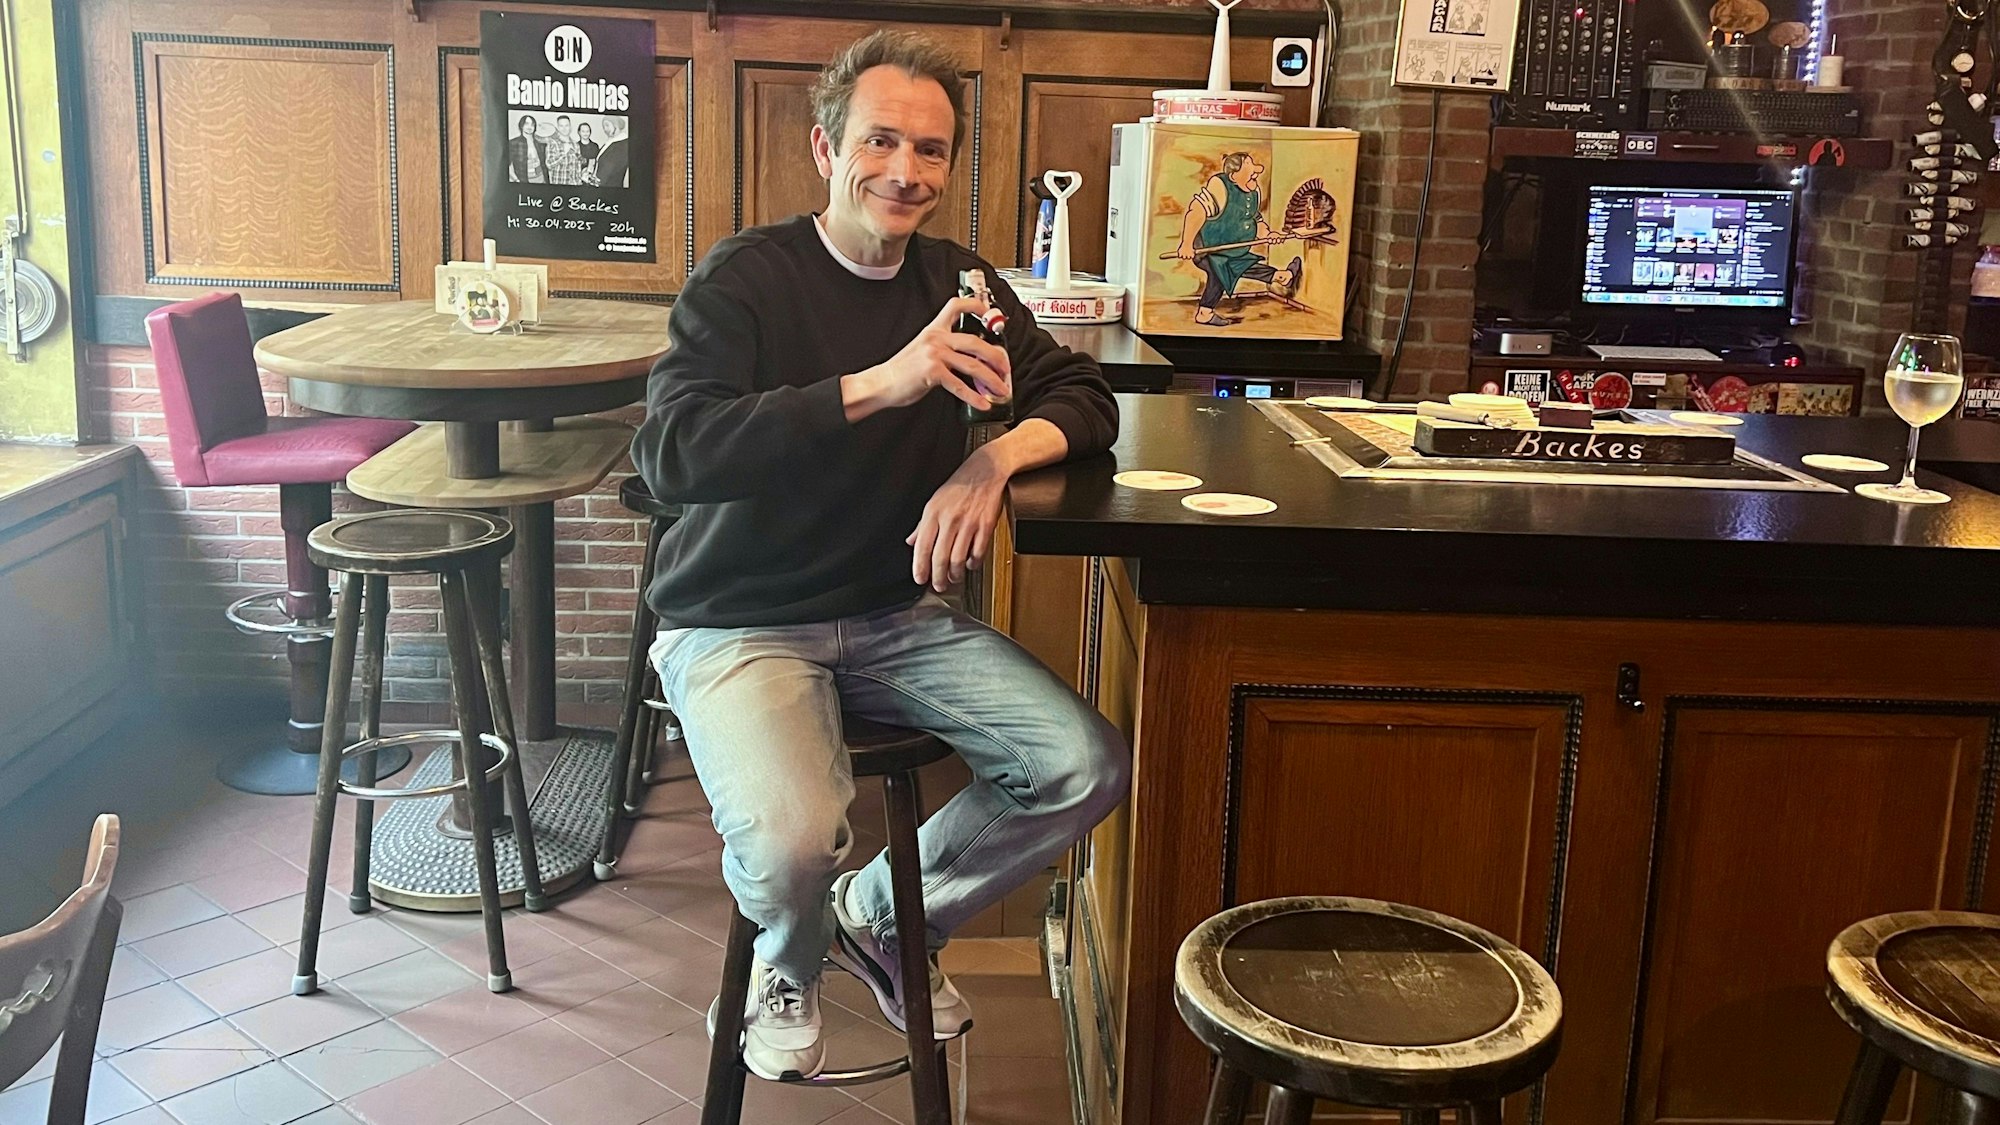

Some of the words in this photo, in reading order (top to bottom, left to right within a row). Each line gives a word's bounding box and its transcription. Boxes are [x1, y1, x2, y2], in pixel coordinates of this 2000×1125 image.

[507, 73, 564, 110] Banjo
[567, 77, 629, 113] Ninjas
[1184, 103, 1223, 114] ULTRAS
[1545, 101, 1591, 113] Numark
[1627, 141, 1654, 151] OBC
[518, 193, 544, 208] Live
[549, 196, 565, 213] @
[568, 198, 619, 215] Backes
[525, 217, 595, 231] 30.04.2025
[610, 221, 635, 235] 20h
[1050, 300, 1087, 315] Kölsch
[1514, 374, 1542, 385] KEINE
[1573, 381, 1595, 390] AFD
[1510, 430, 1644, 460] Backes
